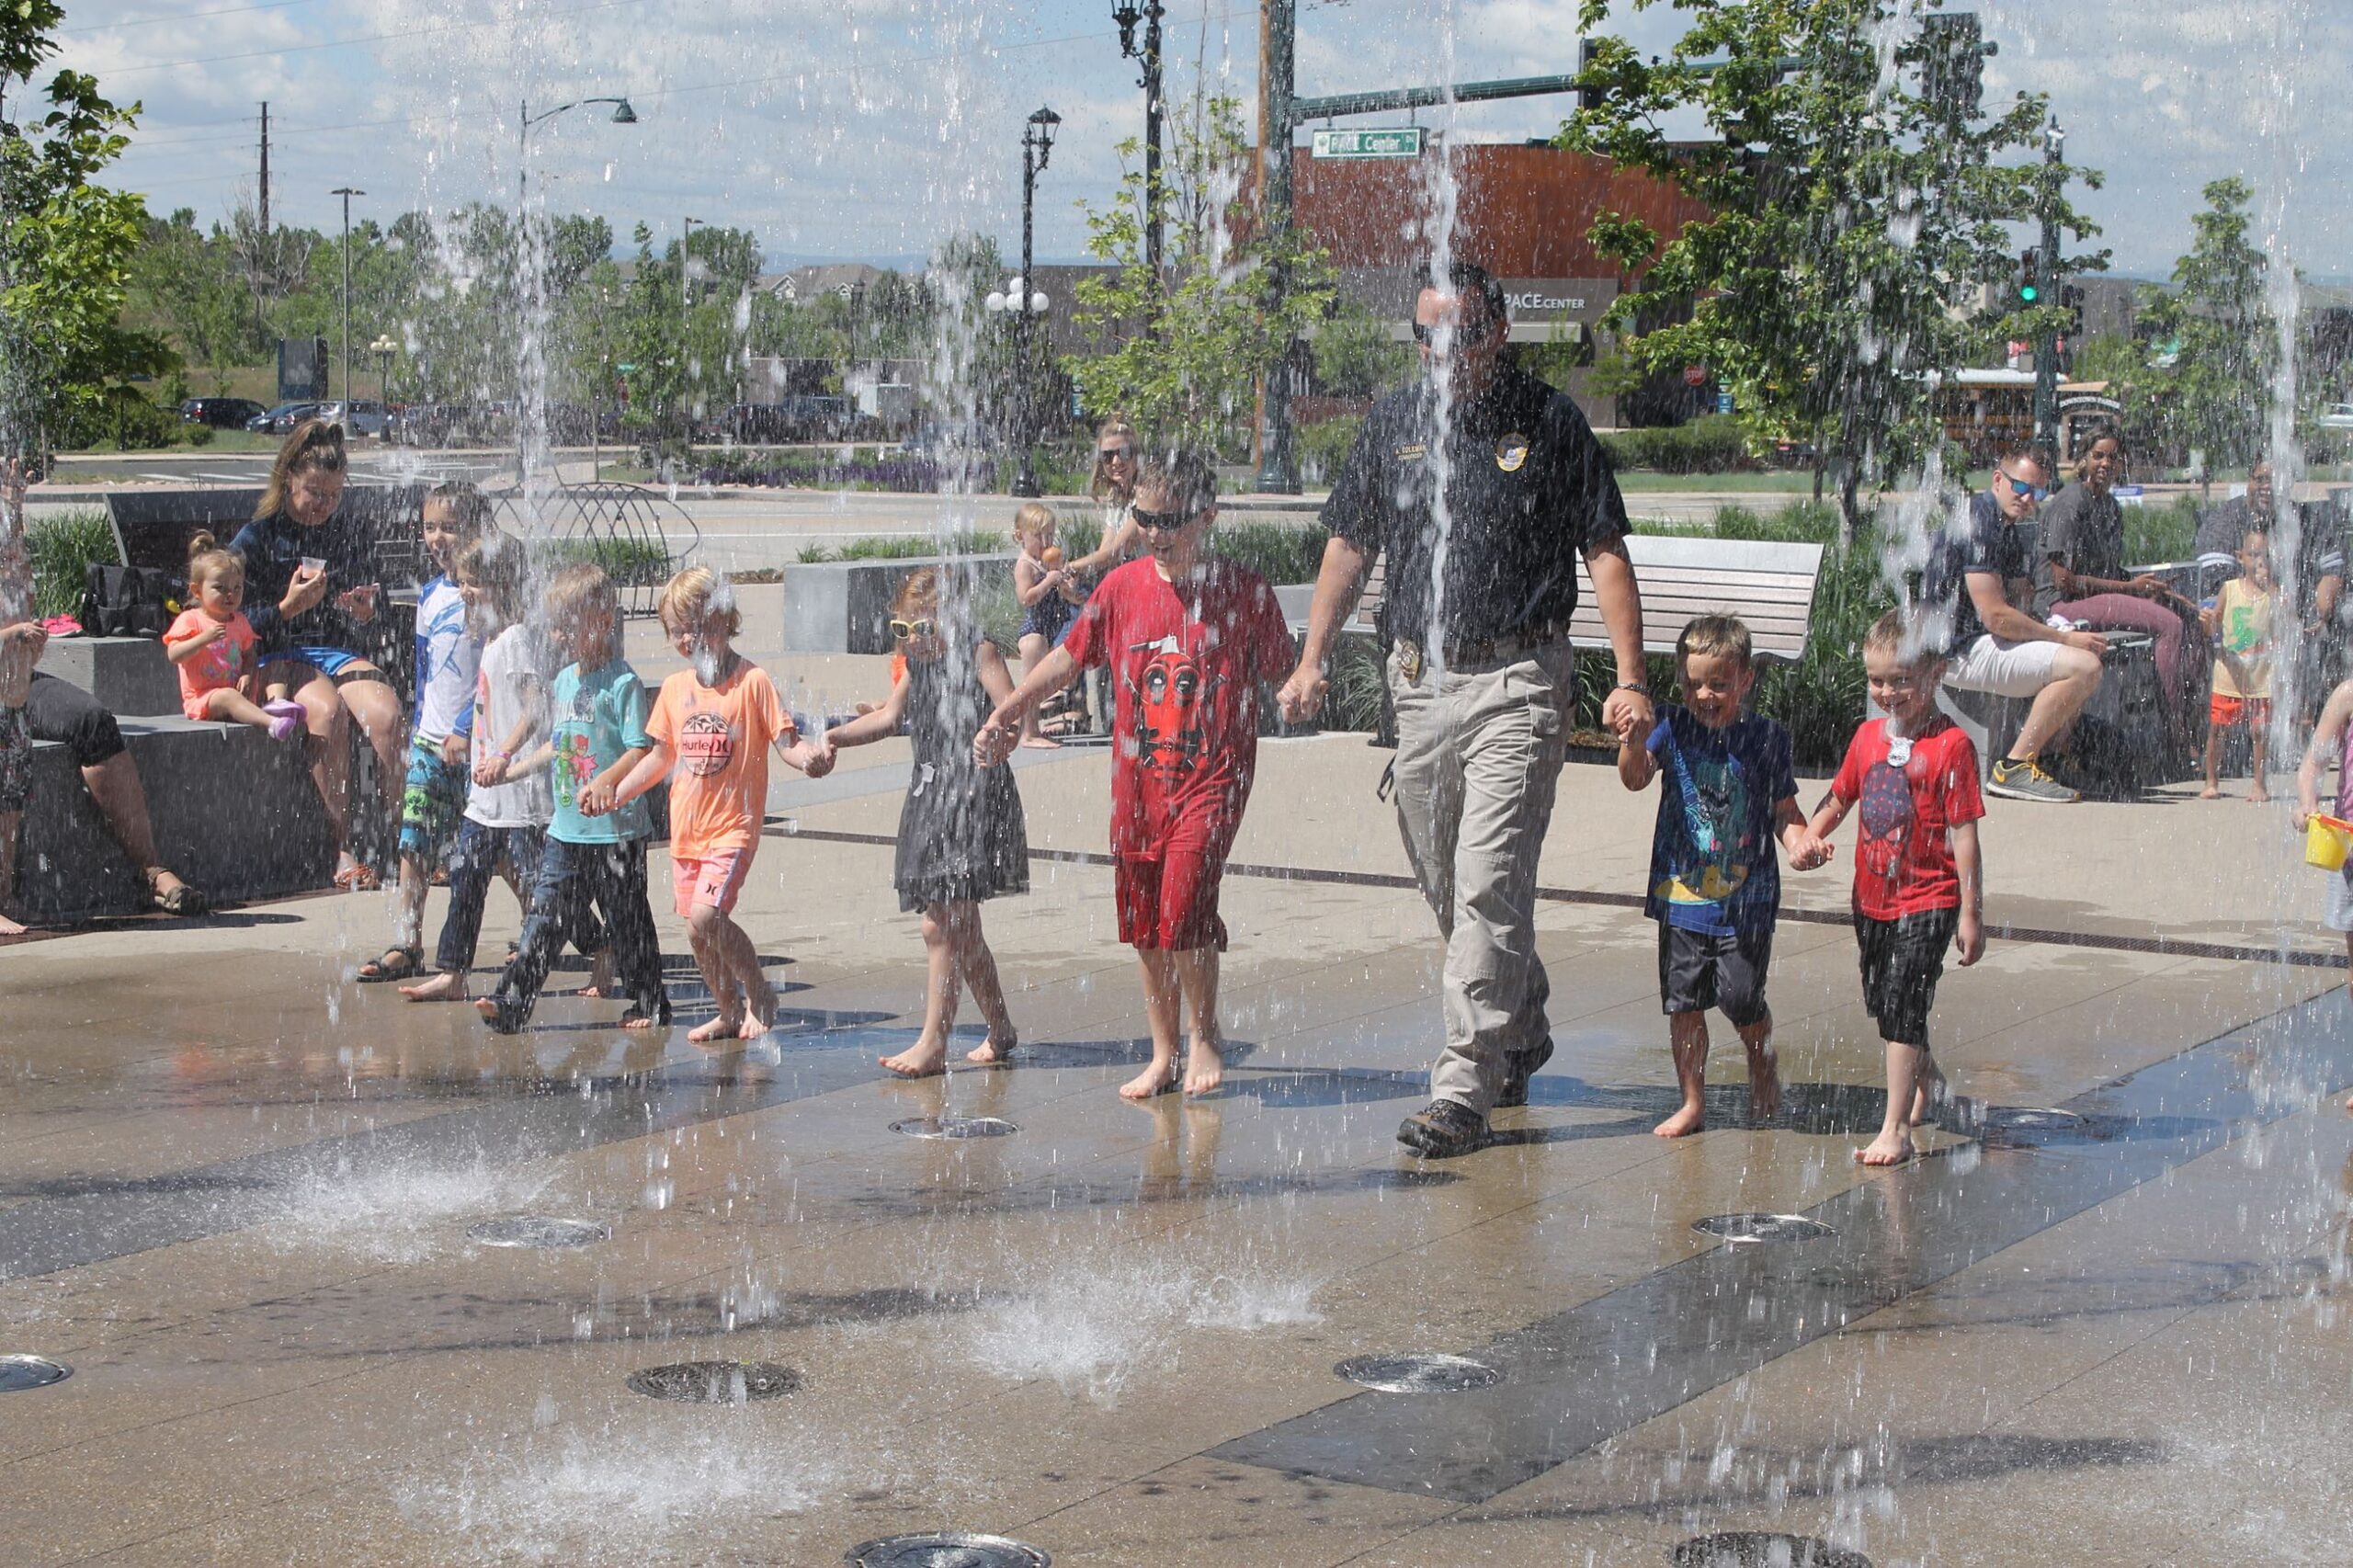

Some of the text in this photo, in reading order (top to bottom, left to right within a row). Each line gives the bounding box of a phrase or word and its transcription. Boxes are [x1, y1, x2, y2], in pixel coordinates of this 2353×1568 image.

[1365, 135, 1401, 152] Center
[1504, 293, 1585, 309] PACE CENTER
[1687, 369, 1703, 379] STOP
[682, 739, 715, 753] Hurley
